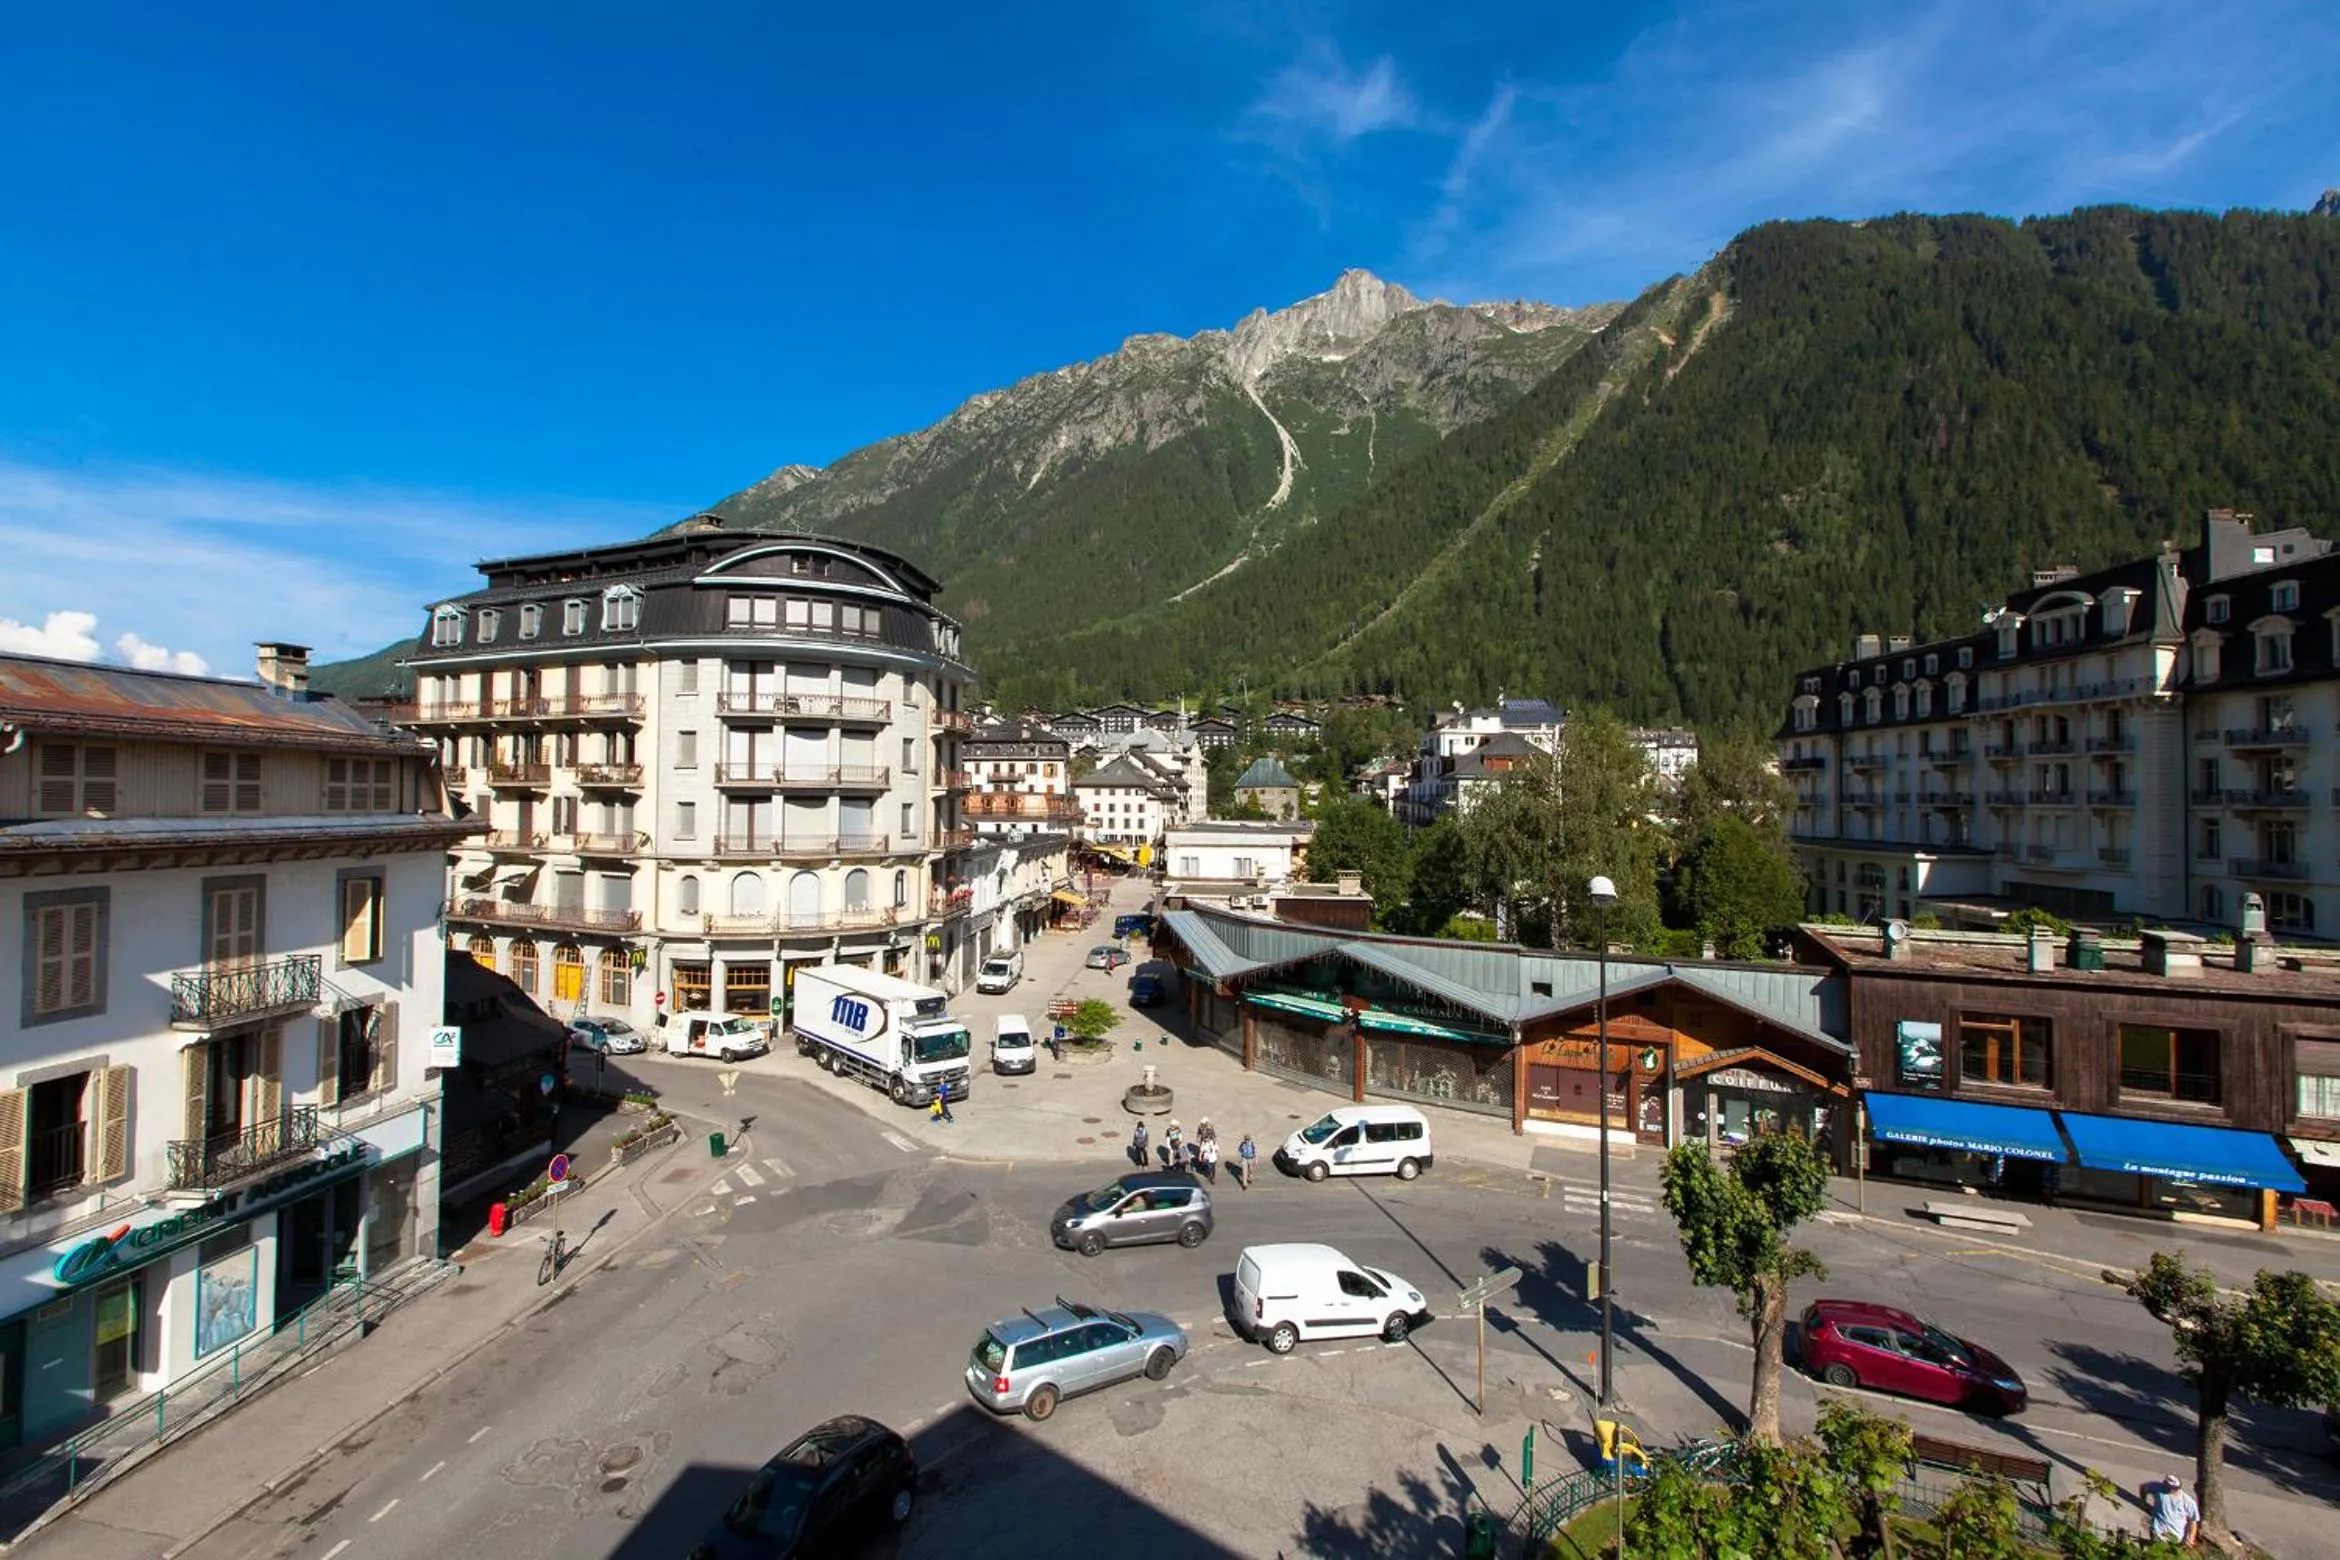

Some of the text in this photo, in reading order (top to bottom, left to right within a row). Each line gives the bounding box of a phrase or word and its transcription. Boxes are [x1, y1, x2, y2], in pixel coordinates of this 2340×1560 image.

[831, 995, 869, 1032] MB
[1403, 1005, 1463, 1020] CADEAUX
[1711, 1073, 1795, 1093] COIFFU
[1886, 1131, 2056, 1161] GALERIE photos MARIO COLONEL
[2140, 1166, 2196, 1178] montagne
[2198, 1172, 2246, 1184] passion
